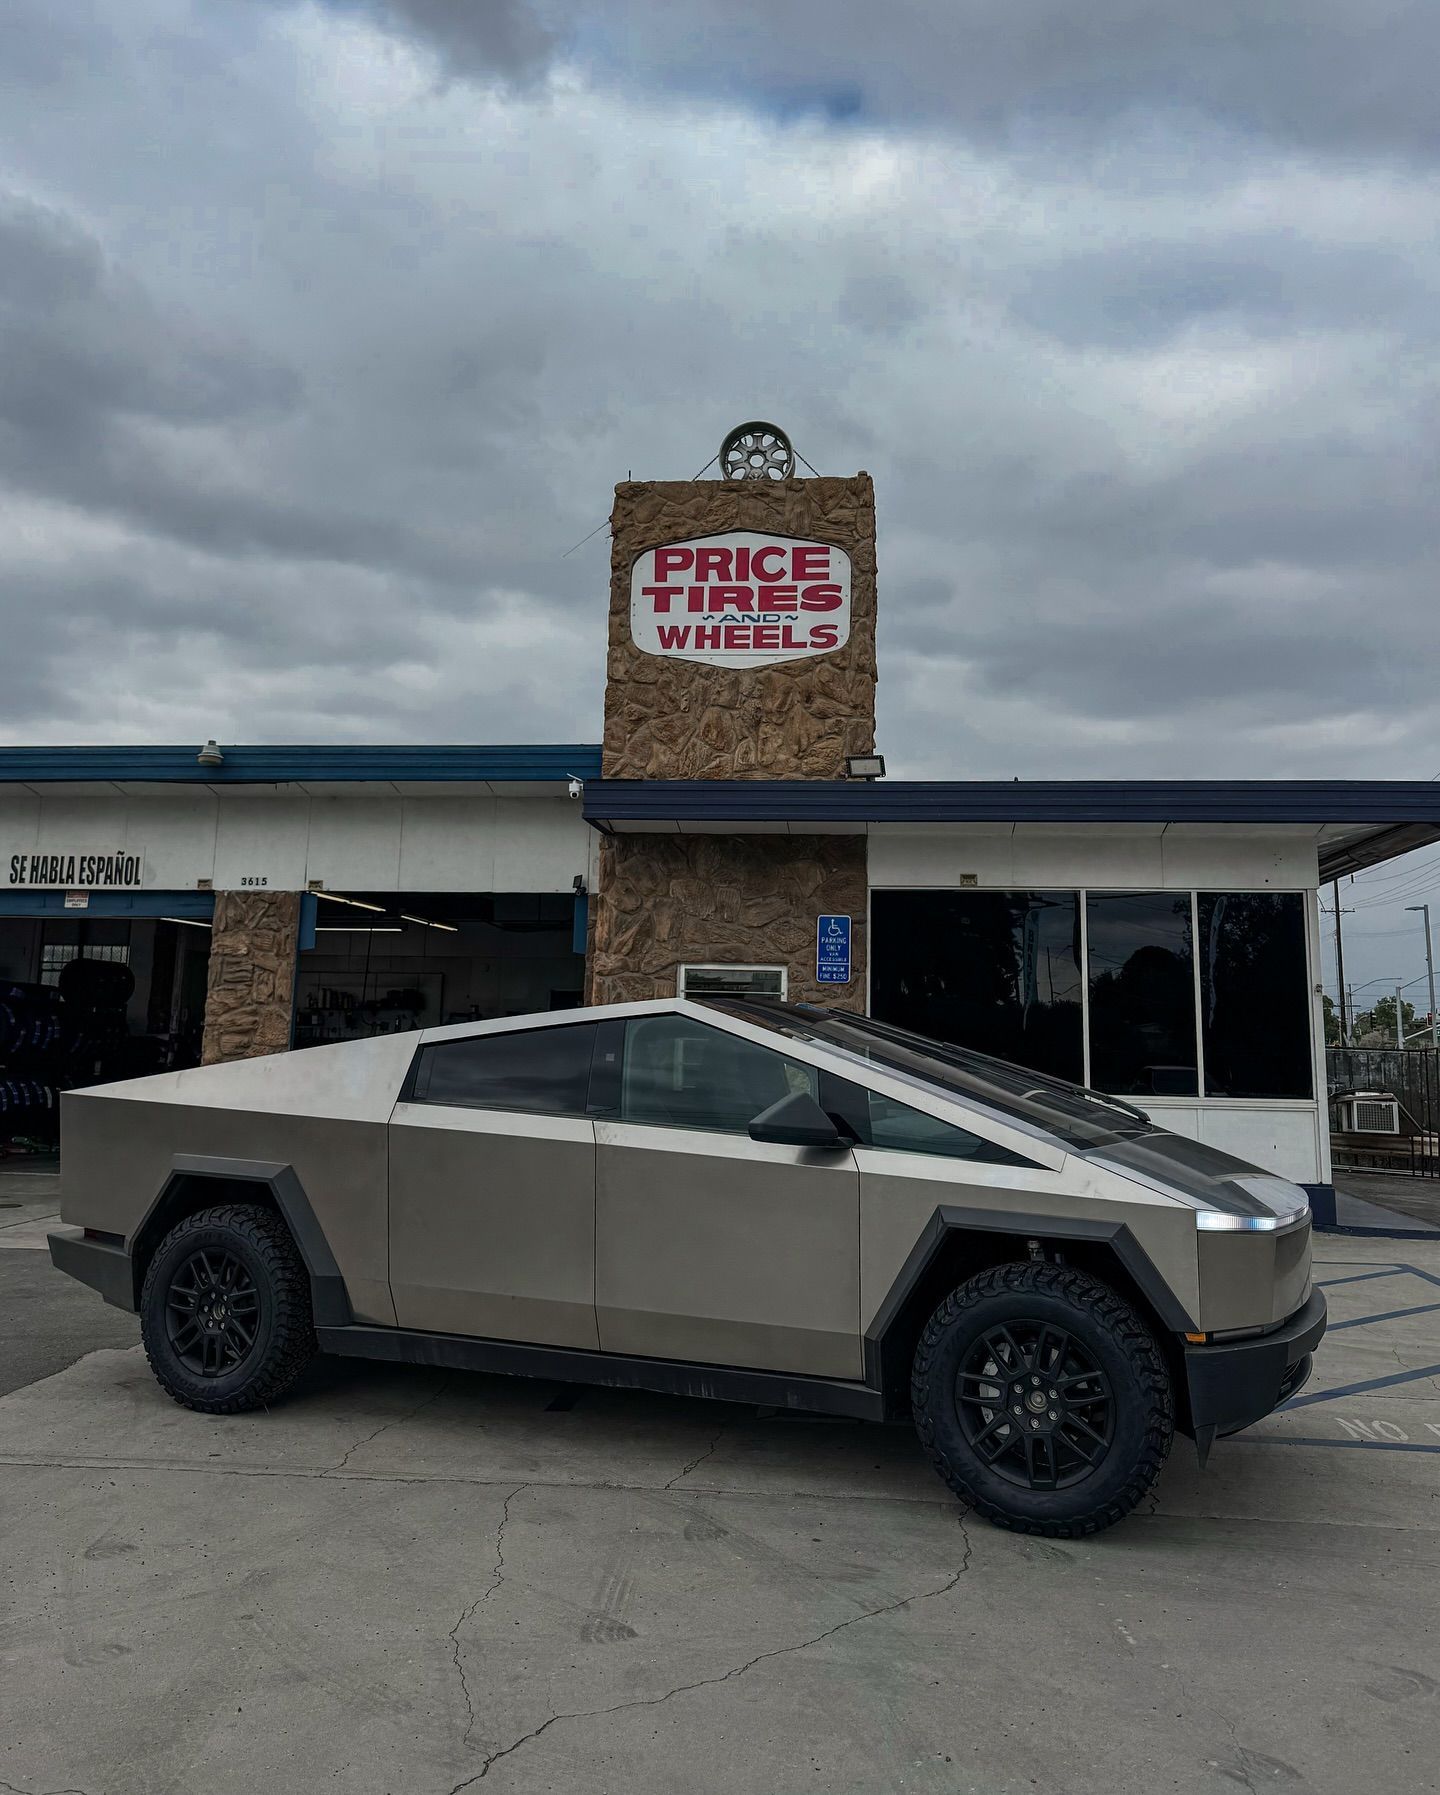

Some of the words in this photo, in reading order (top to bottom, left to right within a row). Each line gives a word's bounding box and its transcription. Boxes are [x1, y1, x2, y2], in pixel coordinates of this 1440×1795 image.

[654, 546, 831, 583] PRICE
[642, 584, 843, 613] TIRES
[718, 614, 781, 623] AND
[657, 624, 839, 650] WHEELS
[10, 854, 28, 884] SE
[29, 855, 75, 885] HABLA
[79, 851, 142, 886] ESPAÑOL
[241, 877, 268, 886] 3615
[1334, 1417, 1409, 1441] NO
